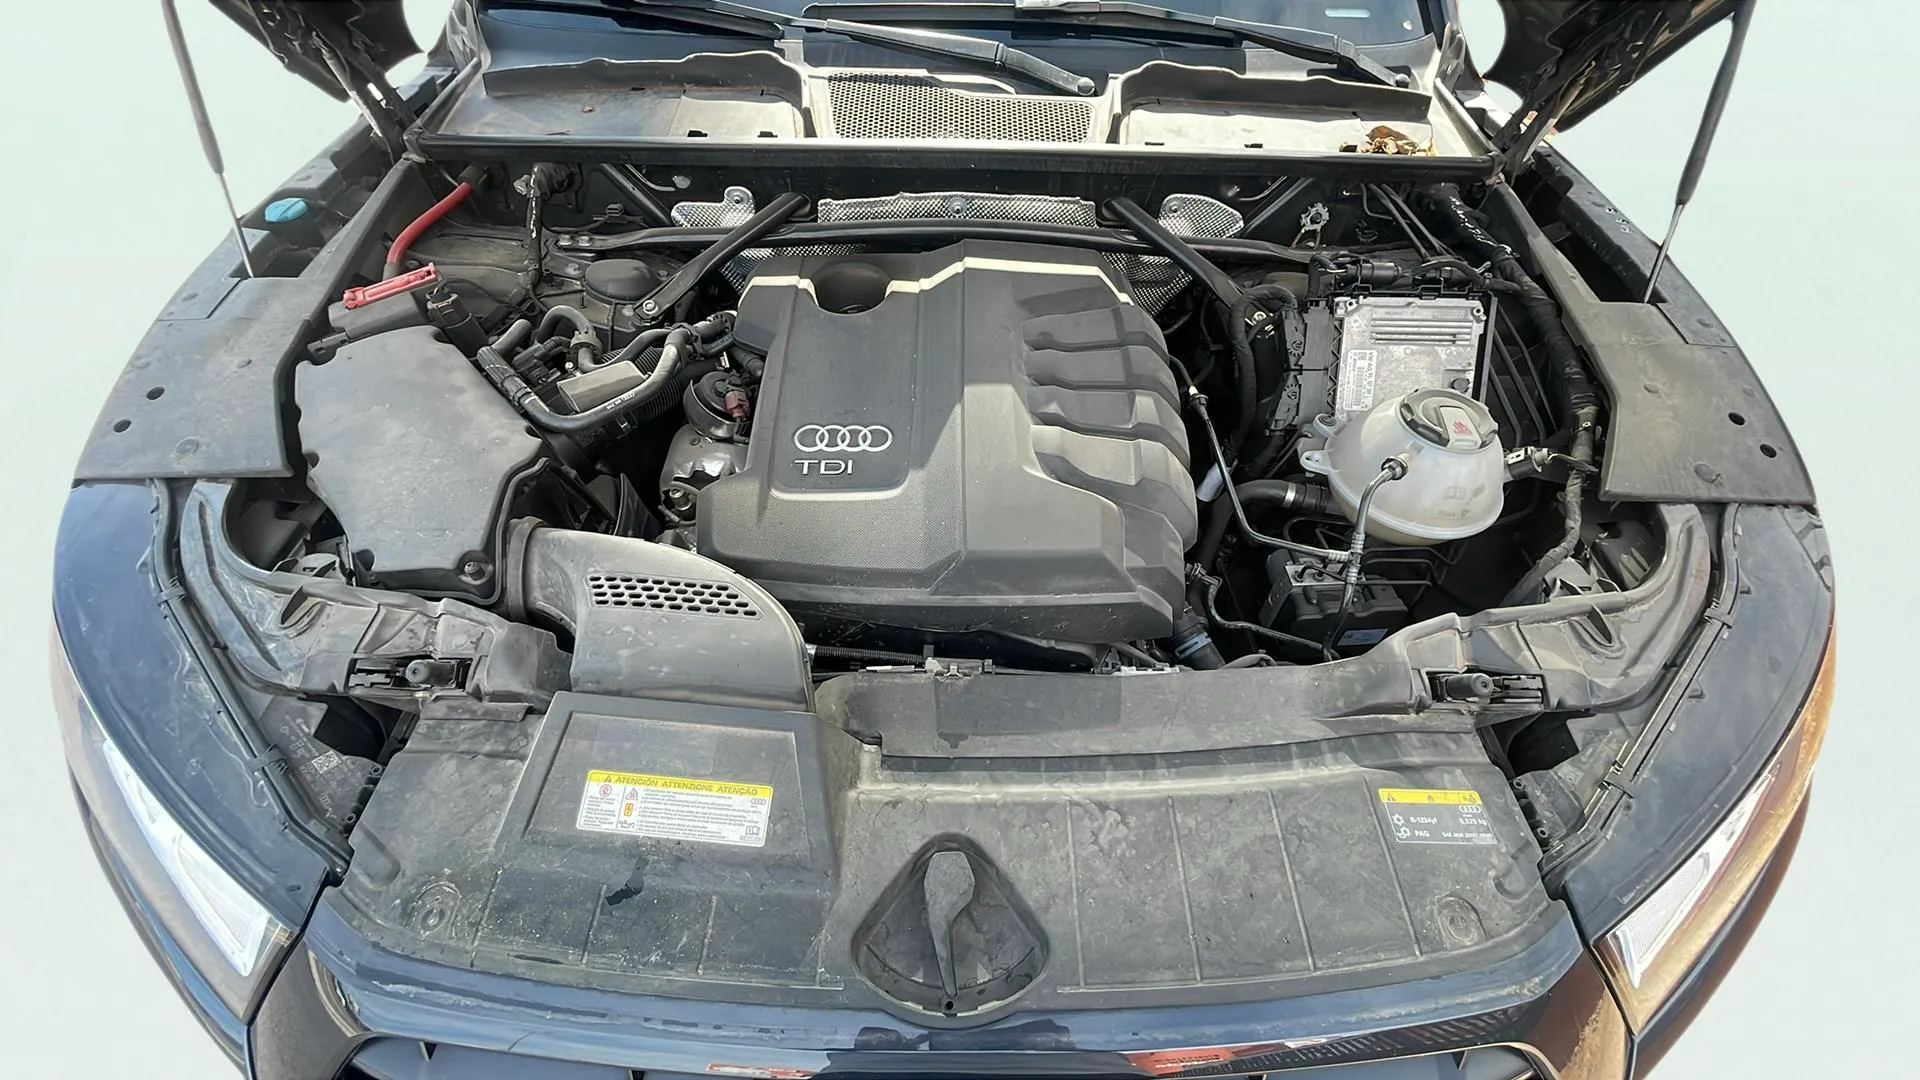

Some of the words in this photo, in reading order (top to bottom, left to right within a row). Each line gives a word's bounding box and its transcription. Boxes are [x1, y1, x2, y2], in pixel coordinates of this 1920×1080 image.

[794, 460, 853, 475] TDI
[615, 776, 658, 786] ATENCIÓN
[661, 780, 713, 792] ATTENZIONE
[716, 786, 758, 796] ATENÇÃO
